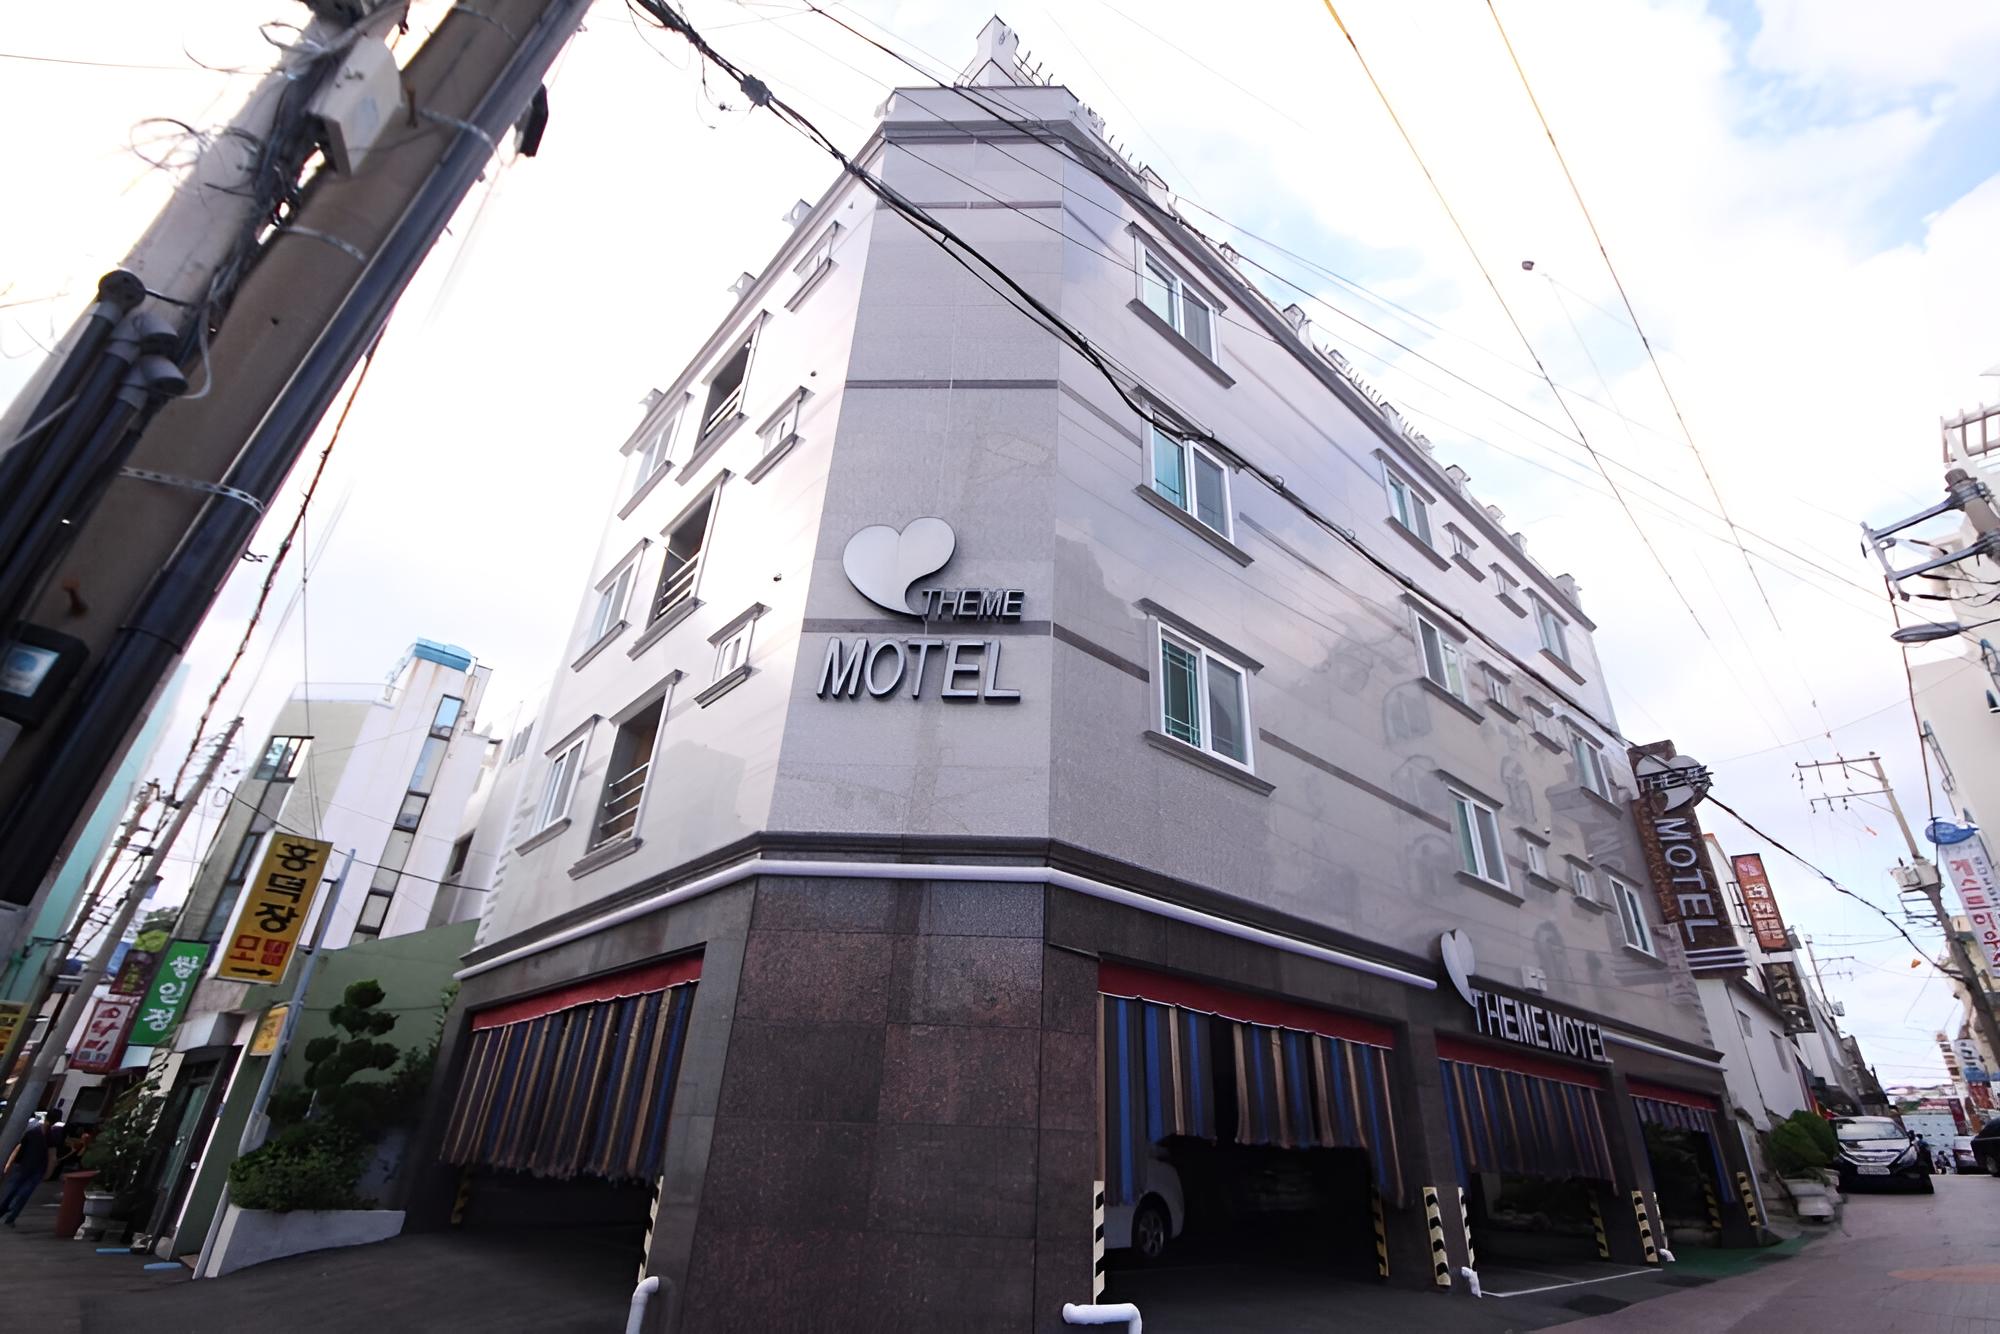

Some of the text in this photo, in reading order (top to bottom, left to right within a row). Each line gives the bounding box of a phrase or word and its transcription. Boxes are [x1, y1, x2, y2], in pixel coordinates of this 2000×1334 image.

[922, 588, 1024, 617] THEME
[816, 636, 1021, 701] MOTEL
[1654, 818, 1719, 943] MOTEL
[1472, 989, 1614, 1063] THEME MOTEL
